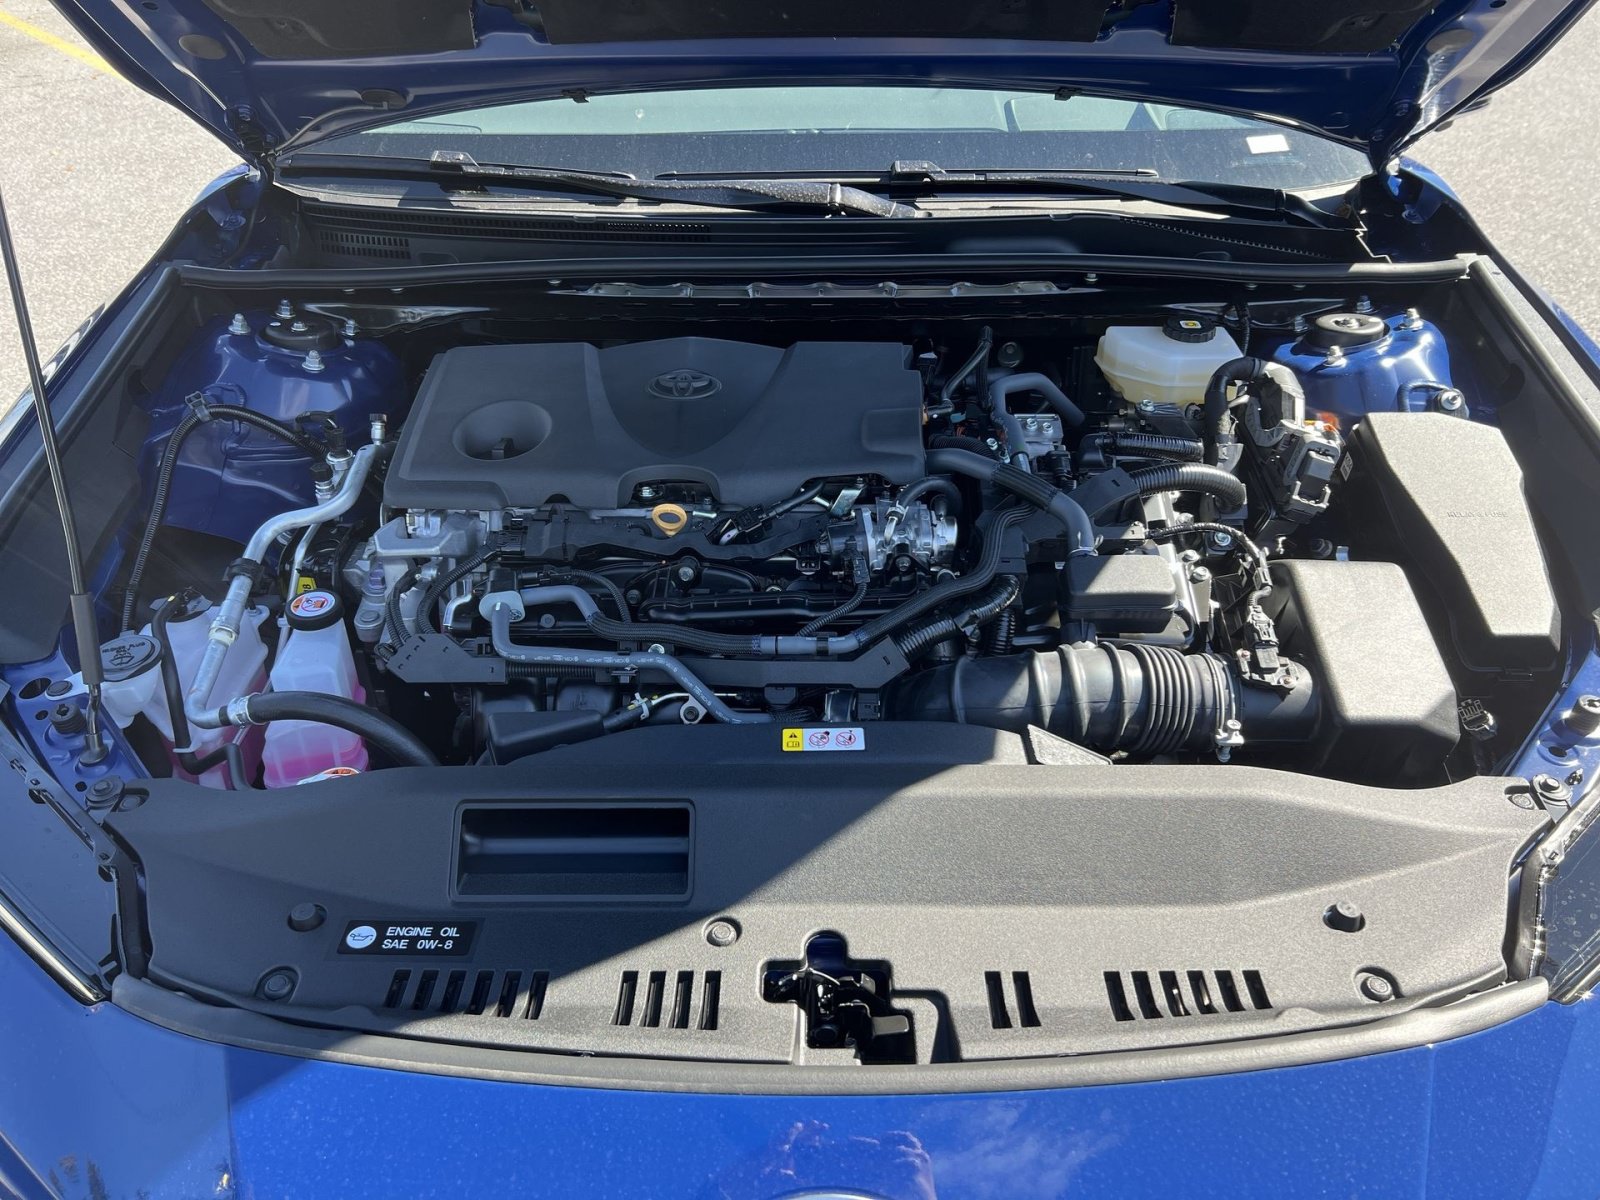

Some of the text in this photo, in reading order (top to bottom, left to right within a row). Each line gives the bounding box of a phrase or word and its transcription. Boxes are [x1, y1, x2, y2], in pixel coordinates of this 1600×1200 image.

[386, 926, 460, 937] ENGINE OIL
[381, 939, 453, 949] SAE 0W-8
